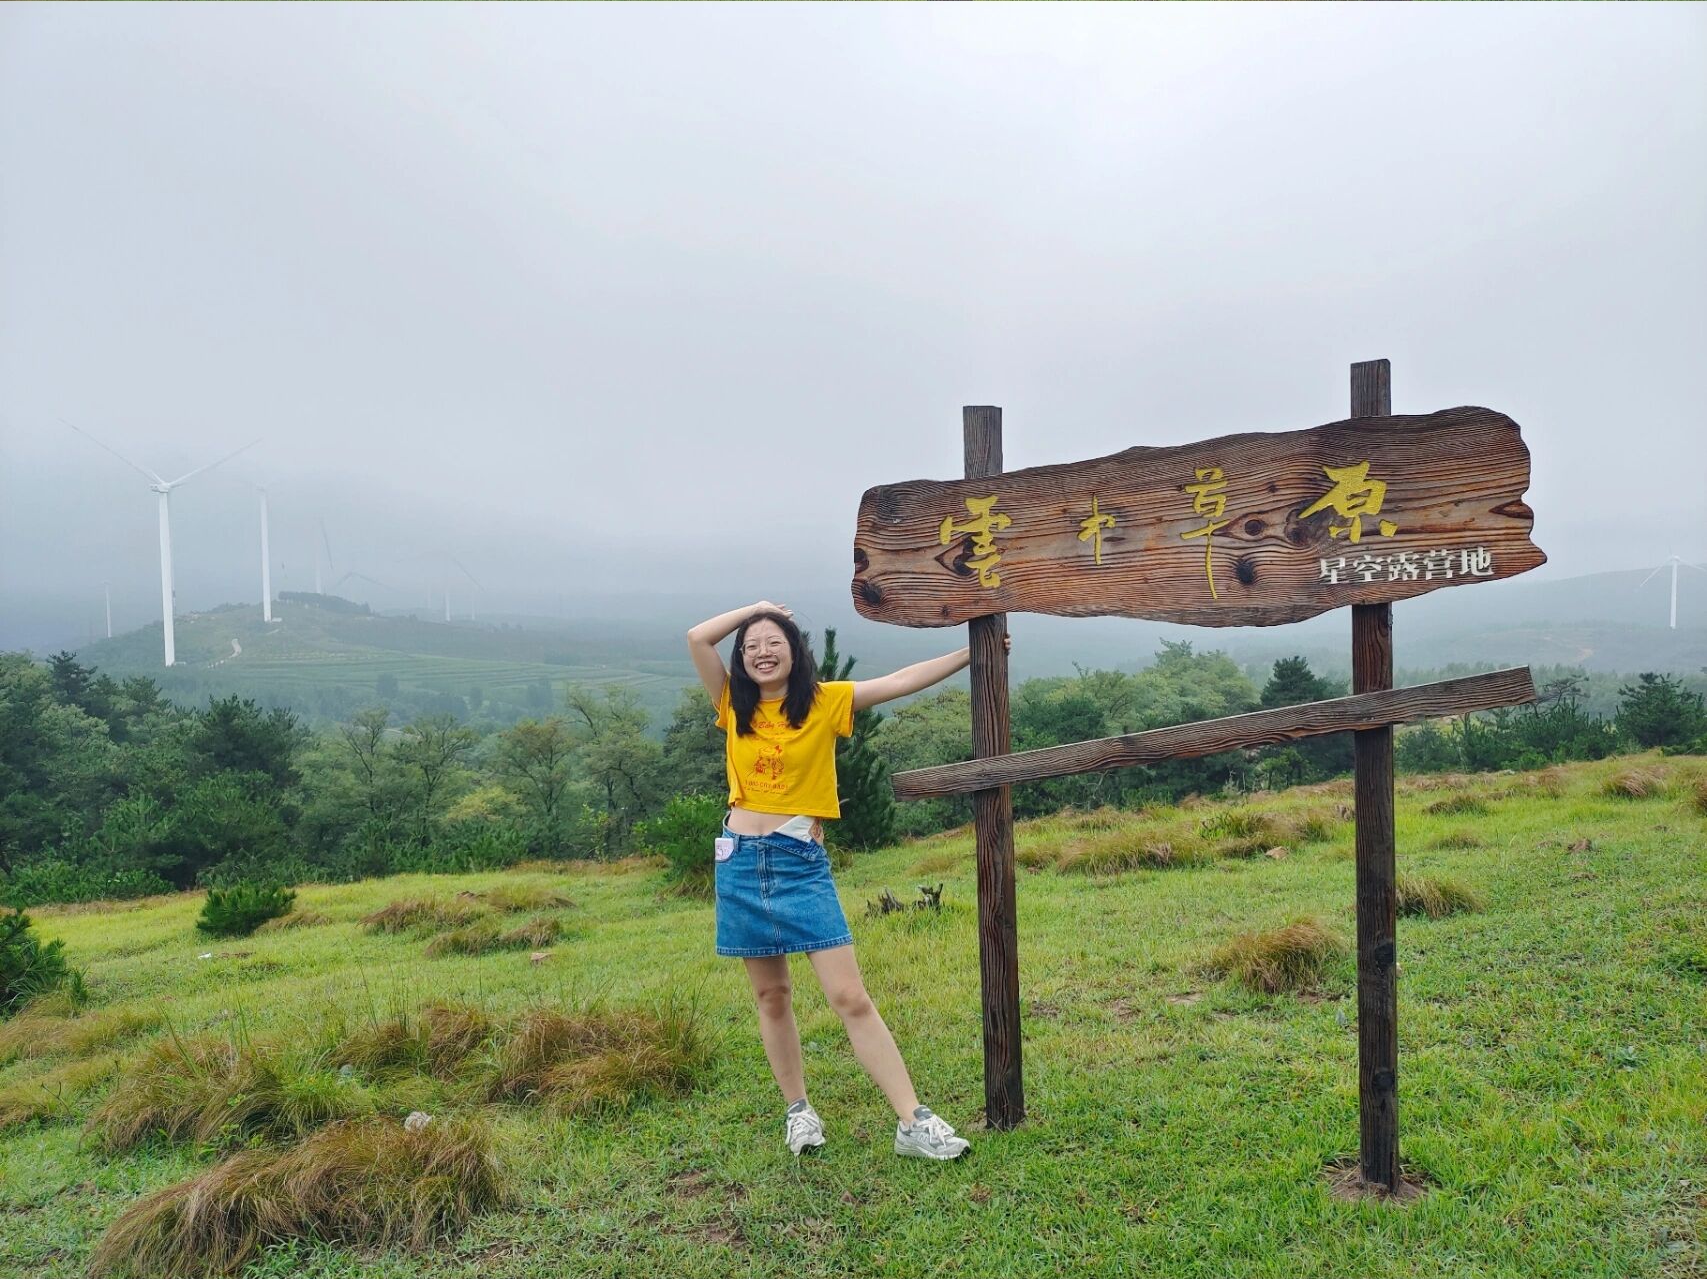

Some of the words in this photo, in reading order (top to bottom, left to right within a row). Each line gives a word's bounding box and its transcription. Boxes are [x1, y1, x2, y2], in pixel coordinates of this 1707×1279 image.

[1319, 547, 1494, 585] 星空露营地
